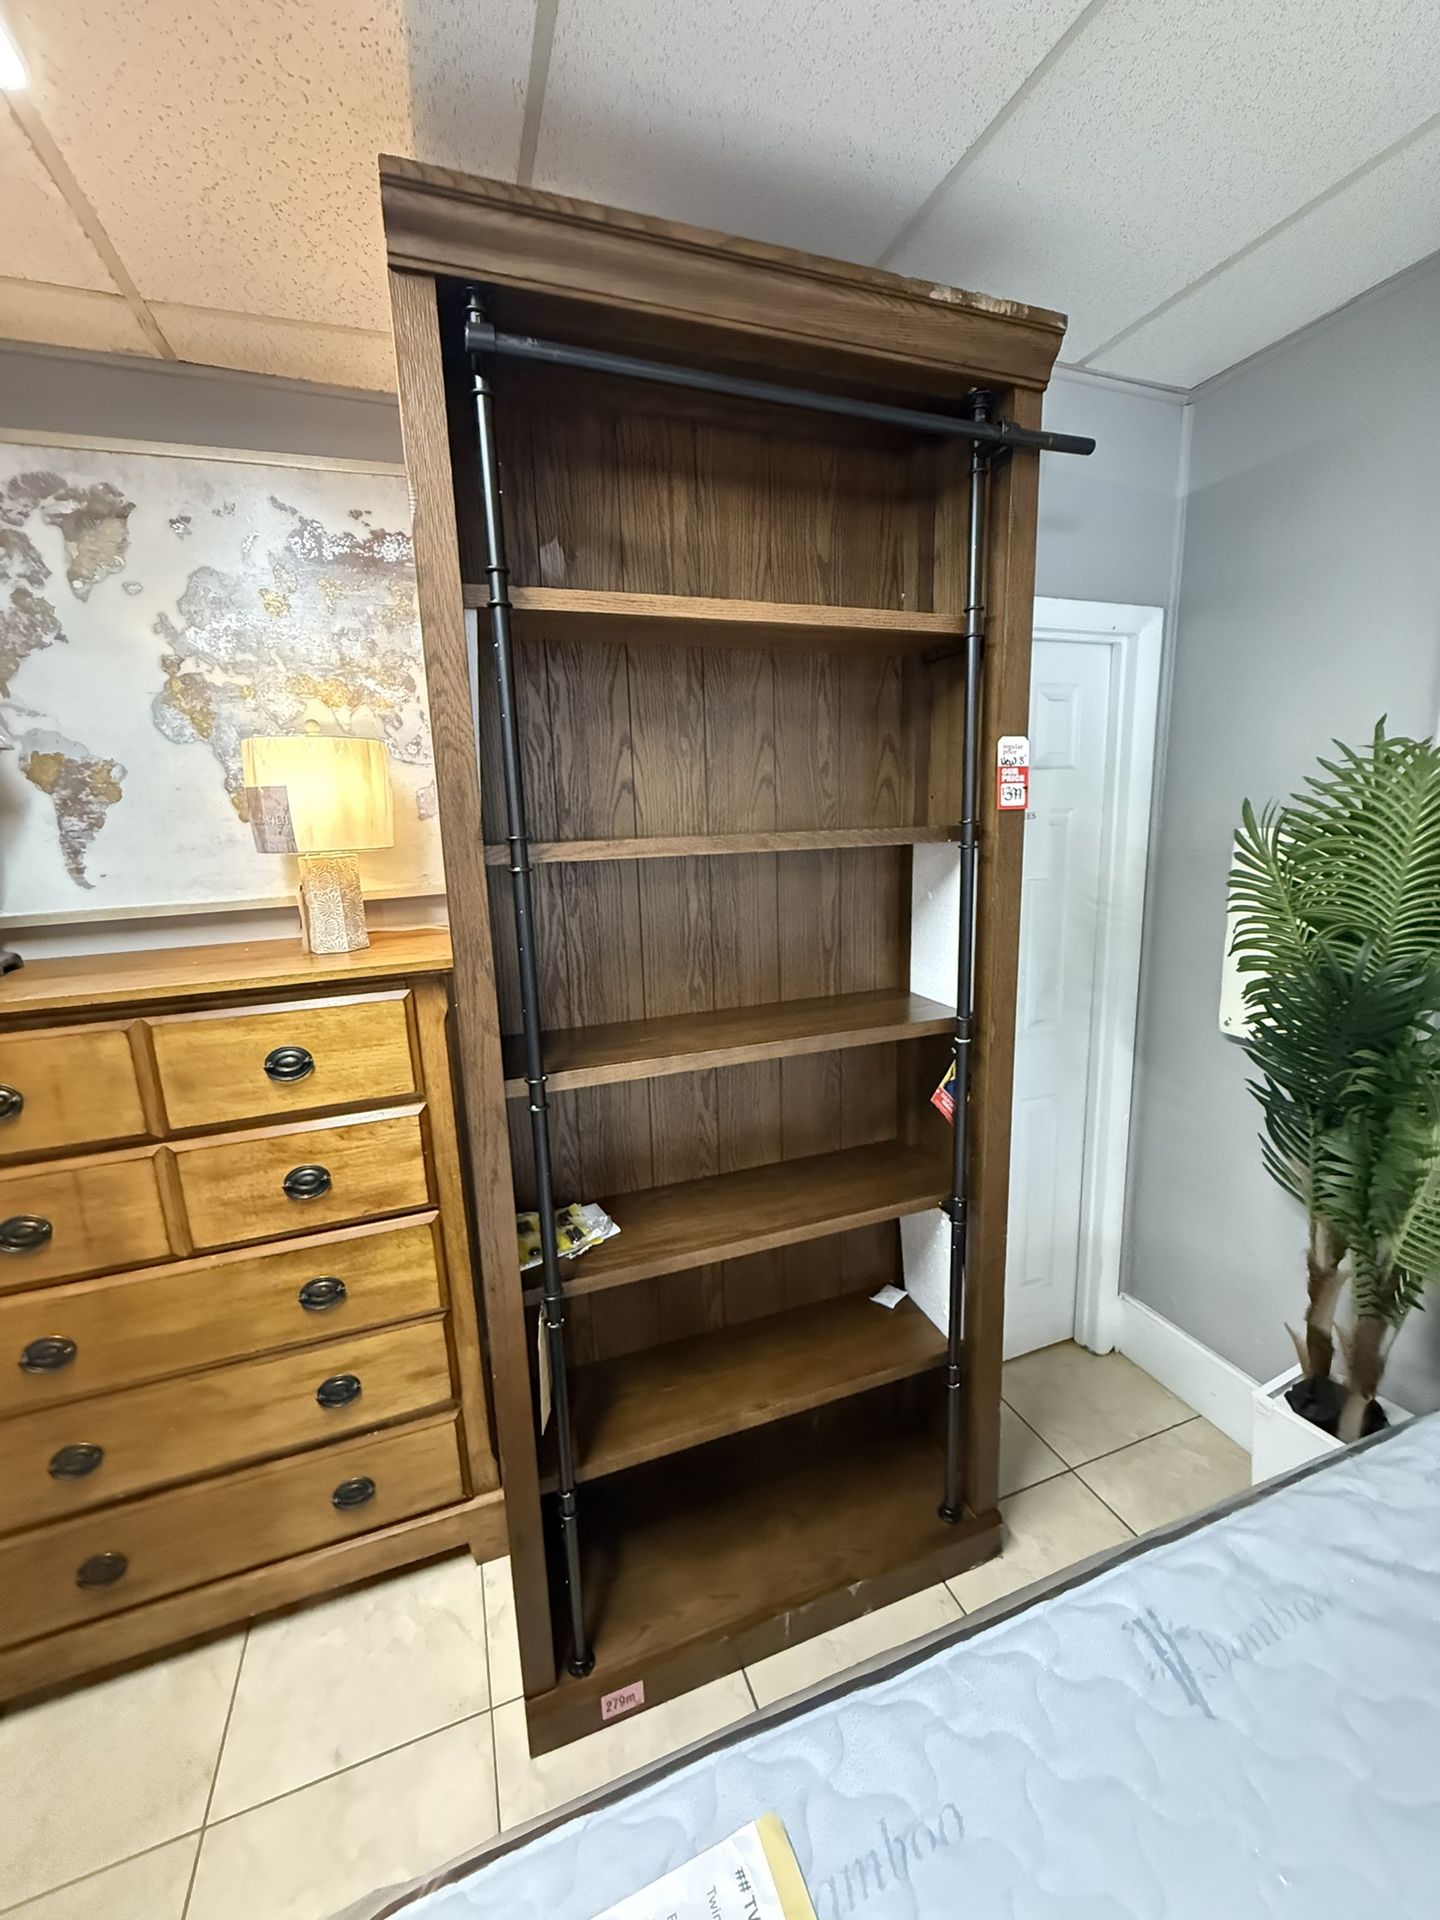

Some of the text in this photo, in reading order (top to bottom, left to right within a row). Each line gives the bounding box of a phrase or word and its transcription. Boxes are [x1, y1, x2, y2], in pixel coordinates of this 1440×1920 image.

[1001, 767, 1019, 775] OUR
[1001, 774, 1025, 783] PRICE
[606, 1693, 636, 1713] 279m
